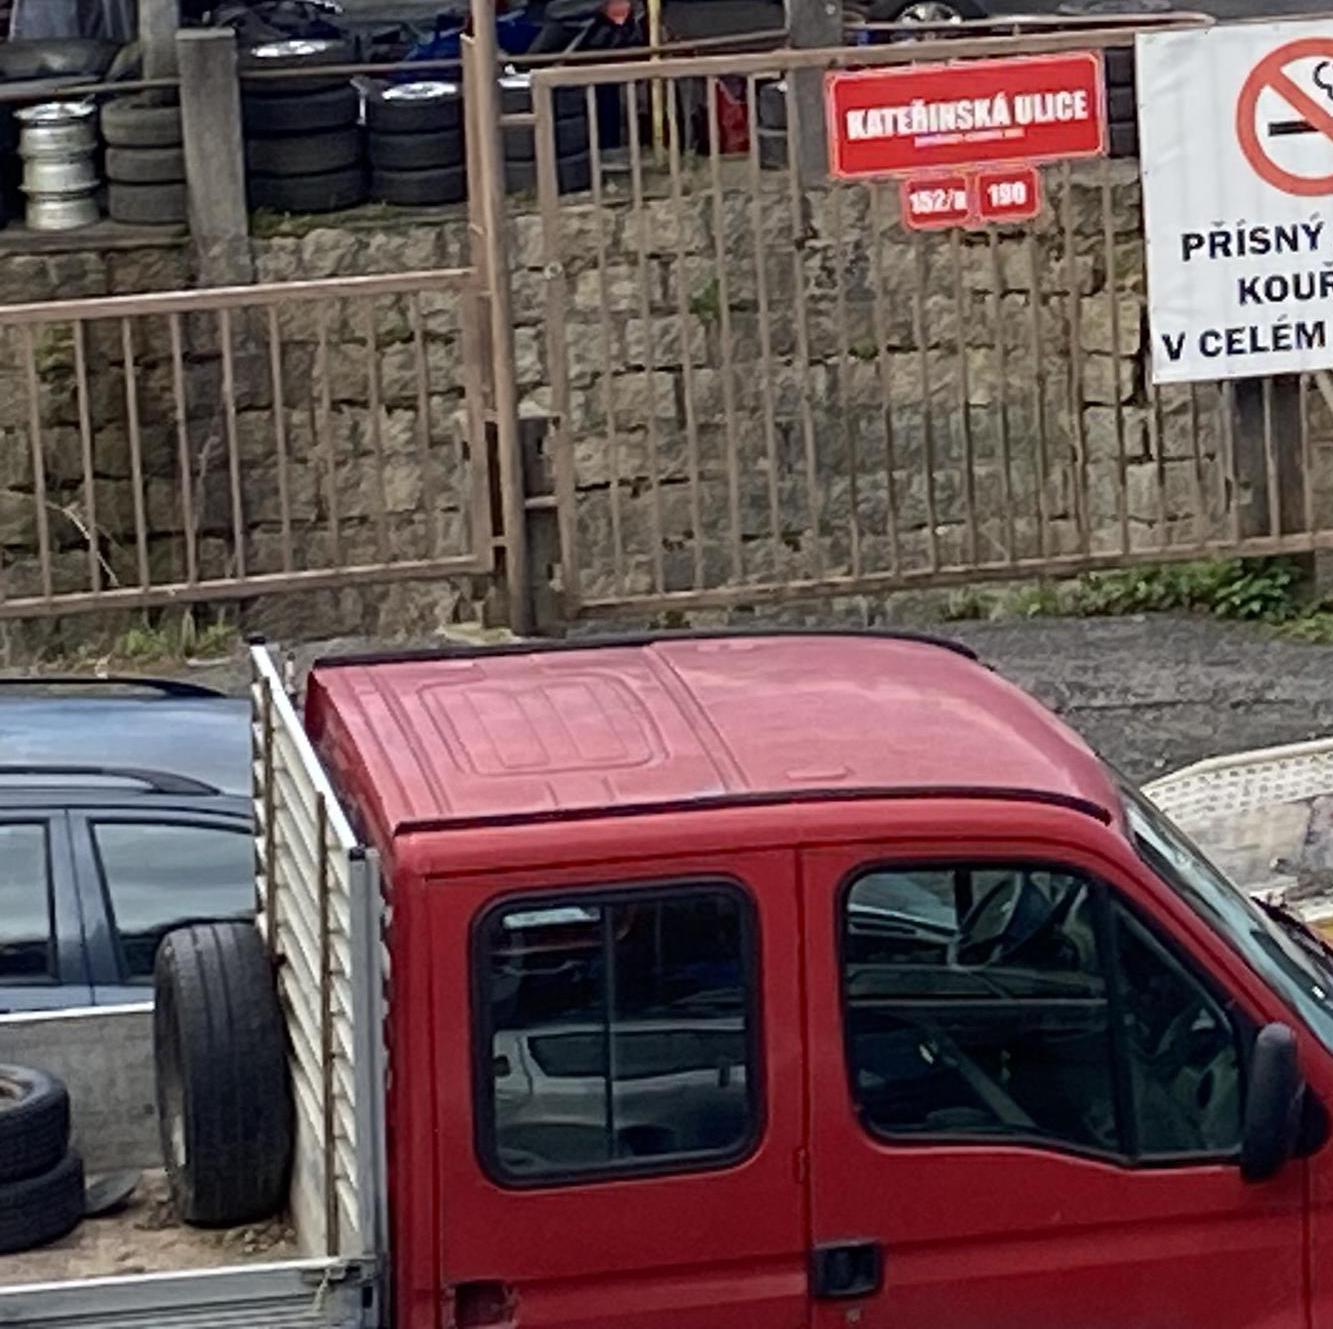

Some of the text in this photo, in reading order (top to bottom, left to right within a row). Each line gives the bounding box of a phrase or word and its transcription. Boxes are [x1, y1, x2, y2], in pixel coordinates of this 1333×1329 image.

[846, 91, 1011, 141] KATEŘINSKÁ
[1014, 90, 1089, 124] ULICE
[1181, 212, 1325, 262] PŘÍSNÝ
[1162, 331, 1187, 362] V
[1199, 313, 1327, 358] CELÉM
